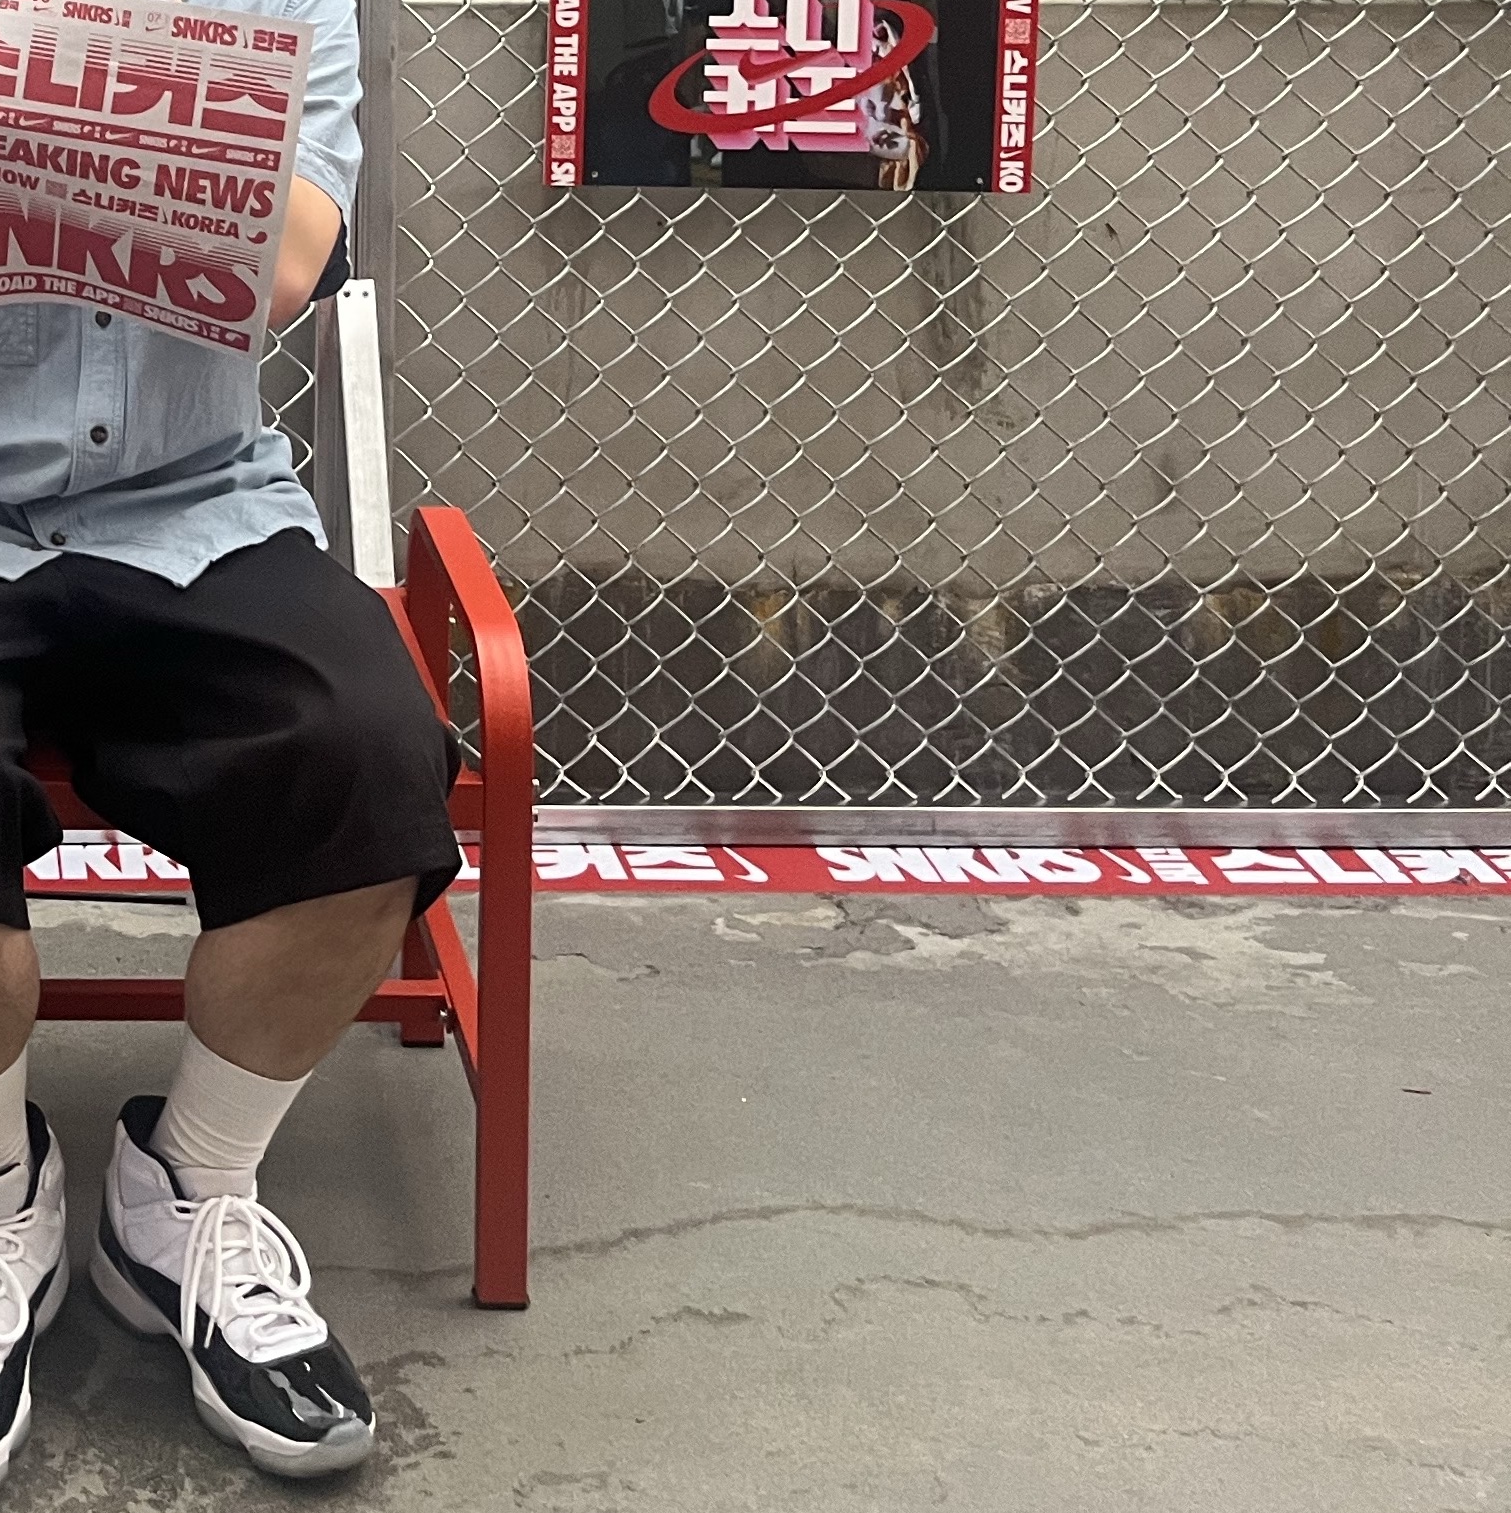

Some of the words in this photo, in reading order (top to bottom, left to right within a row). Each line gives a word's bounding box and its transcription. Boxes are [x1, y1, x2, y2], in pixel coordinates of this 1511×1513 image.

[62, 0, 113, 24] SNKRS
[171, 16, 239, 46] SNKRS
[252, 29, 298, 56] 한국
[553, 33, 579, 77] THE
[551, 82, 577, 132] APP
[1000, 49, 1029, 148] 스니커즈
[153, 164, 276, 219] NEWS
[998, 160, 1025, 193] KO
[72, 189, 159, 222] 스니커즈
[171, 210, 240, 240] KOREA
[43, 276, 77, 295] THE
[82, 284, 121, 304] APP
[815, 846, 1102, 884] SNKRS
[1210, 847, 1511, 885] 스니커
